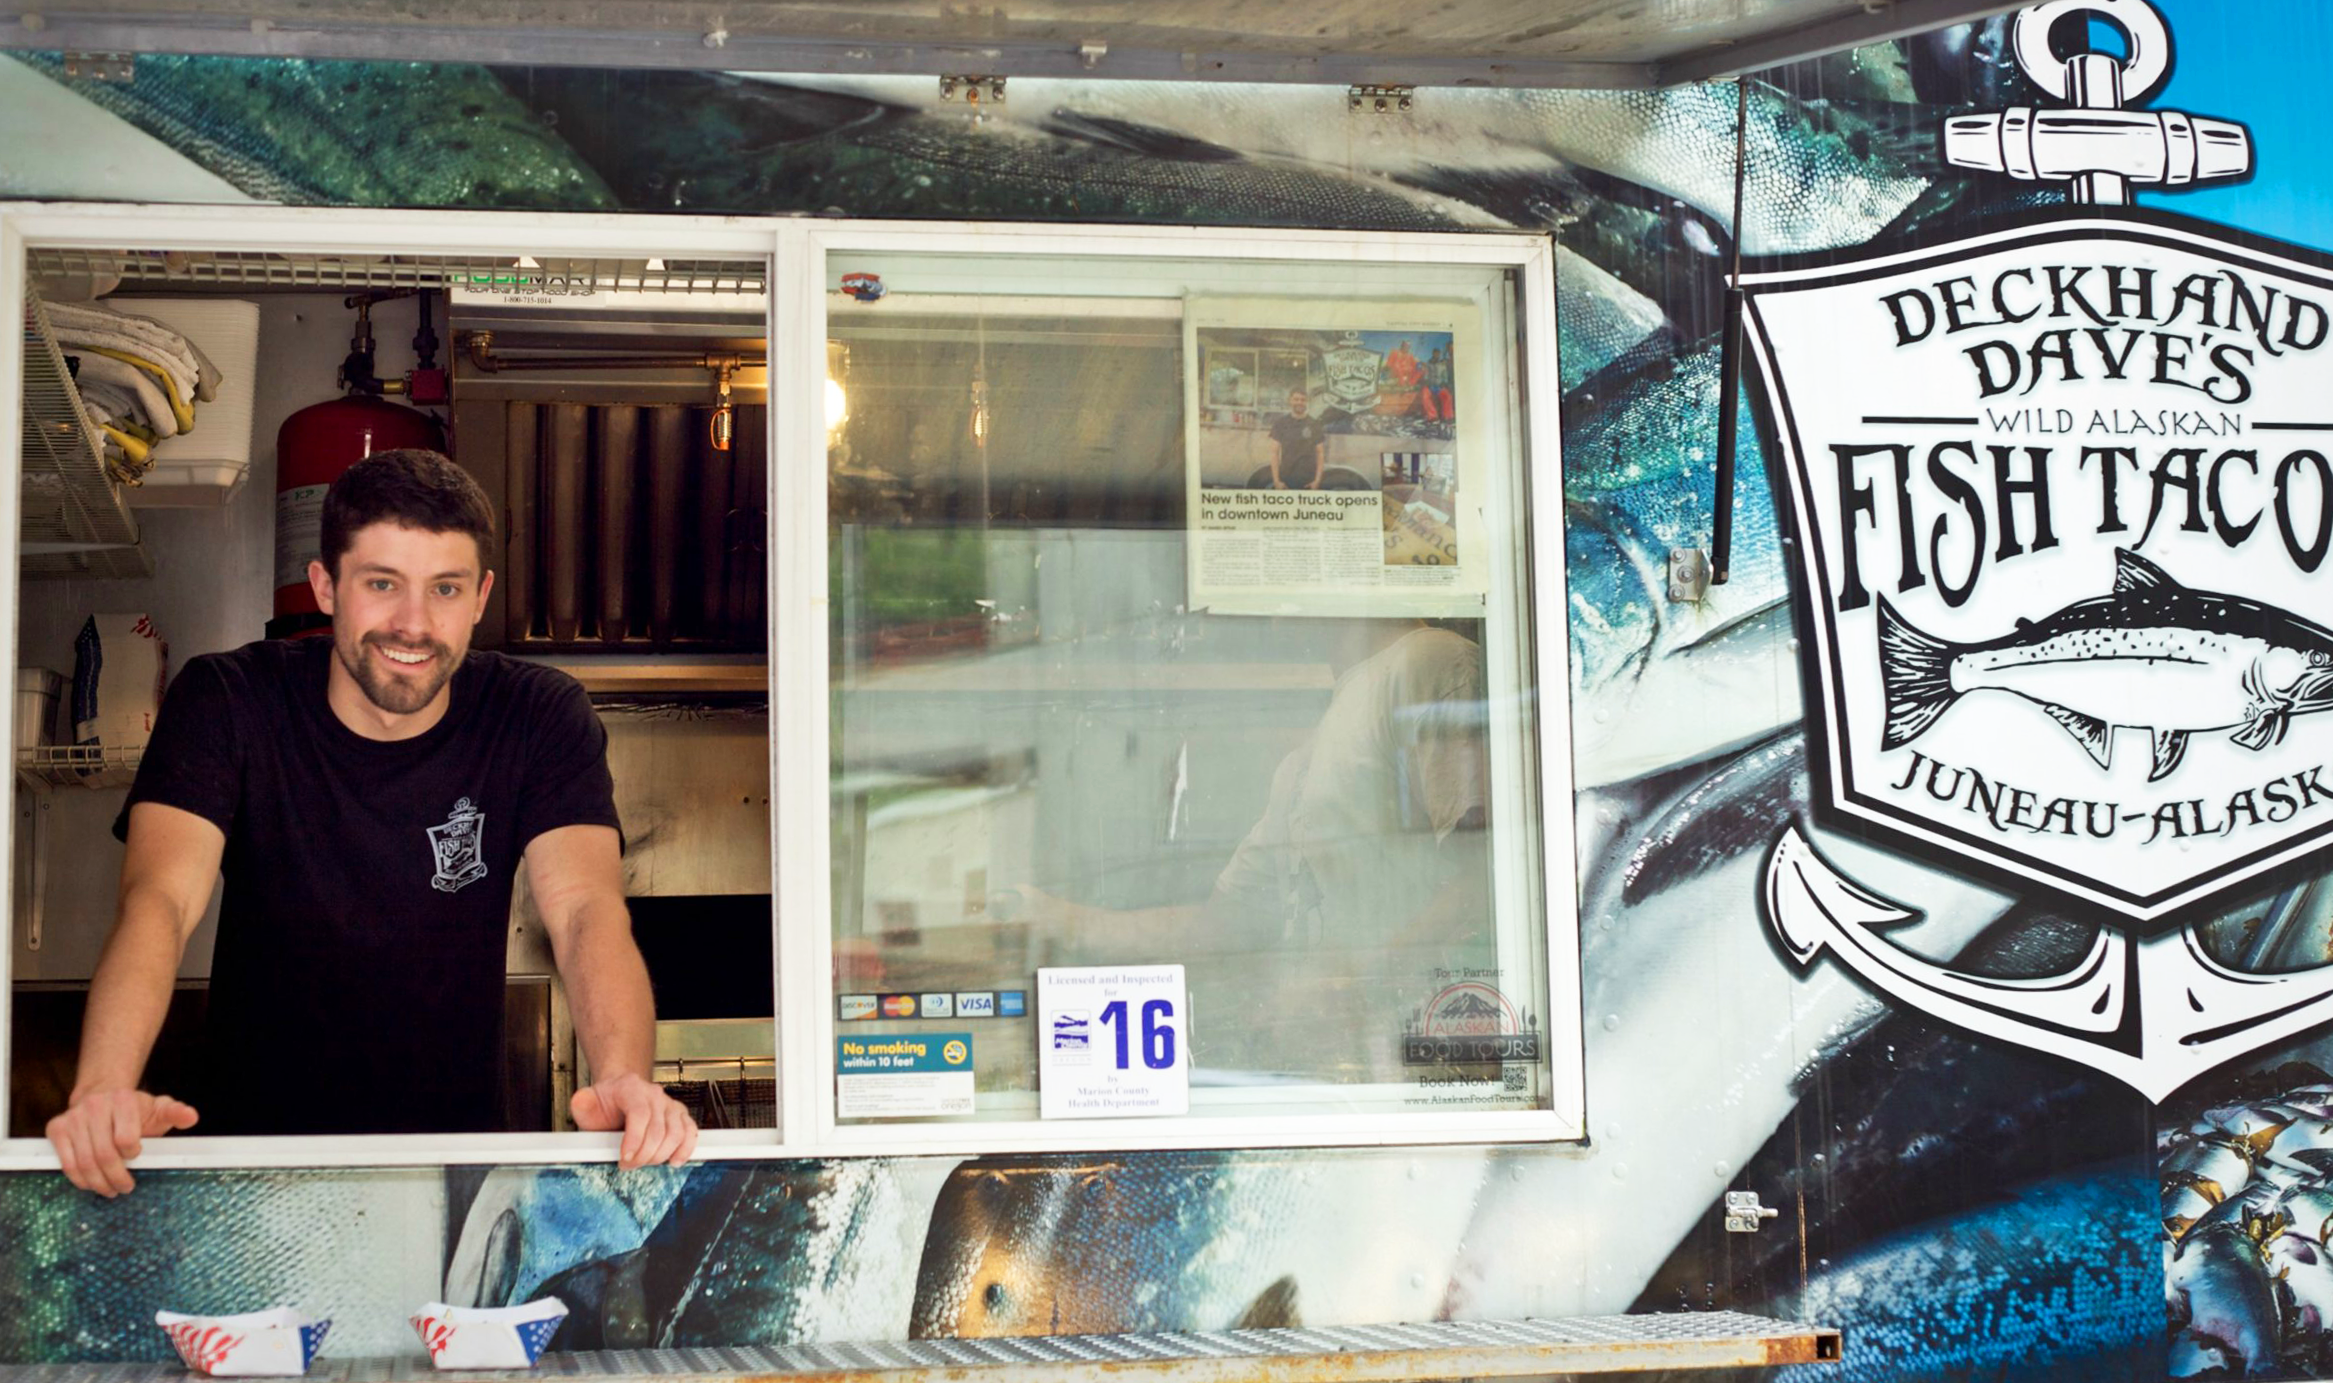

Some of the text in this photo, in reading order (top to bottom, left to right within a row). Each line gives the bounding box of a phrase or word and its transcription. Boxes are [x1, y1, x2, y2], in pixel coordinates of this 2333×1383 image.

[1879, 264, 2330, 356] DECKHAND
[1962, 327, 2256, 404] DAVE'S
[1986, 407, 2243, 437] WILD ALASKAN
[1201, 493, 1378, 508] New fish taco truck opens
[1201, 508, 1343, 521] in downtown Juneau
[1828, 440, 2333, 612] FISH TACO
[1434, 967, 1504, 978] Tour Partner
[1048, 974, 1173, 986] Licensed and Inspected
[1104, 989, 1118, 998] for
[960, 998, 993, 1011] VISA
[1433, 1020, 1509, 1034] ALASKAN
[1099, 999, 1175, 1070] 16
[843, 1040, 927, 1057] No smoking
[1410, 1040, 1535, 1059] FOOD TOURS
[843, 1056, 914, 1068] within 10 feet
[1107, 1075, 1118, 1084] by
[1419, 1075, 1495, 1087] Book Now!
[1078, 1086, 1149, 1097] Marion County
[1068, 1098, 1160, 1109] Health Department
